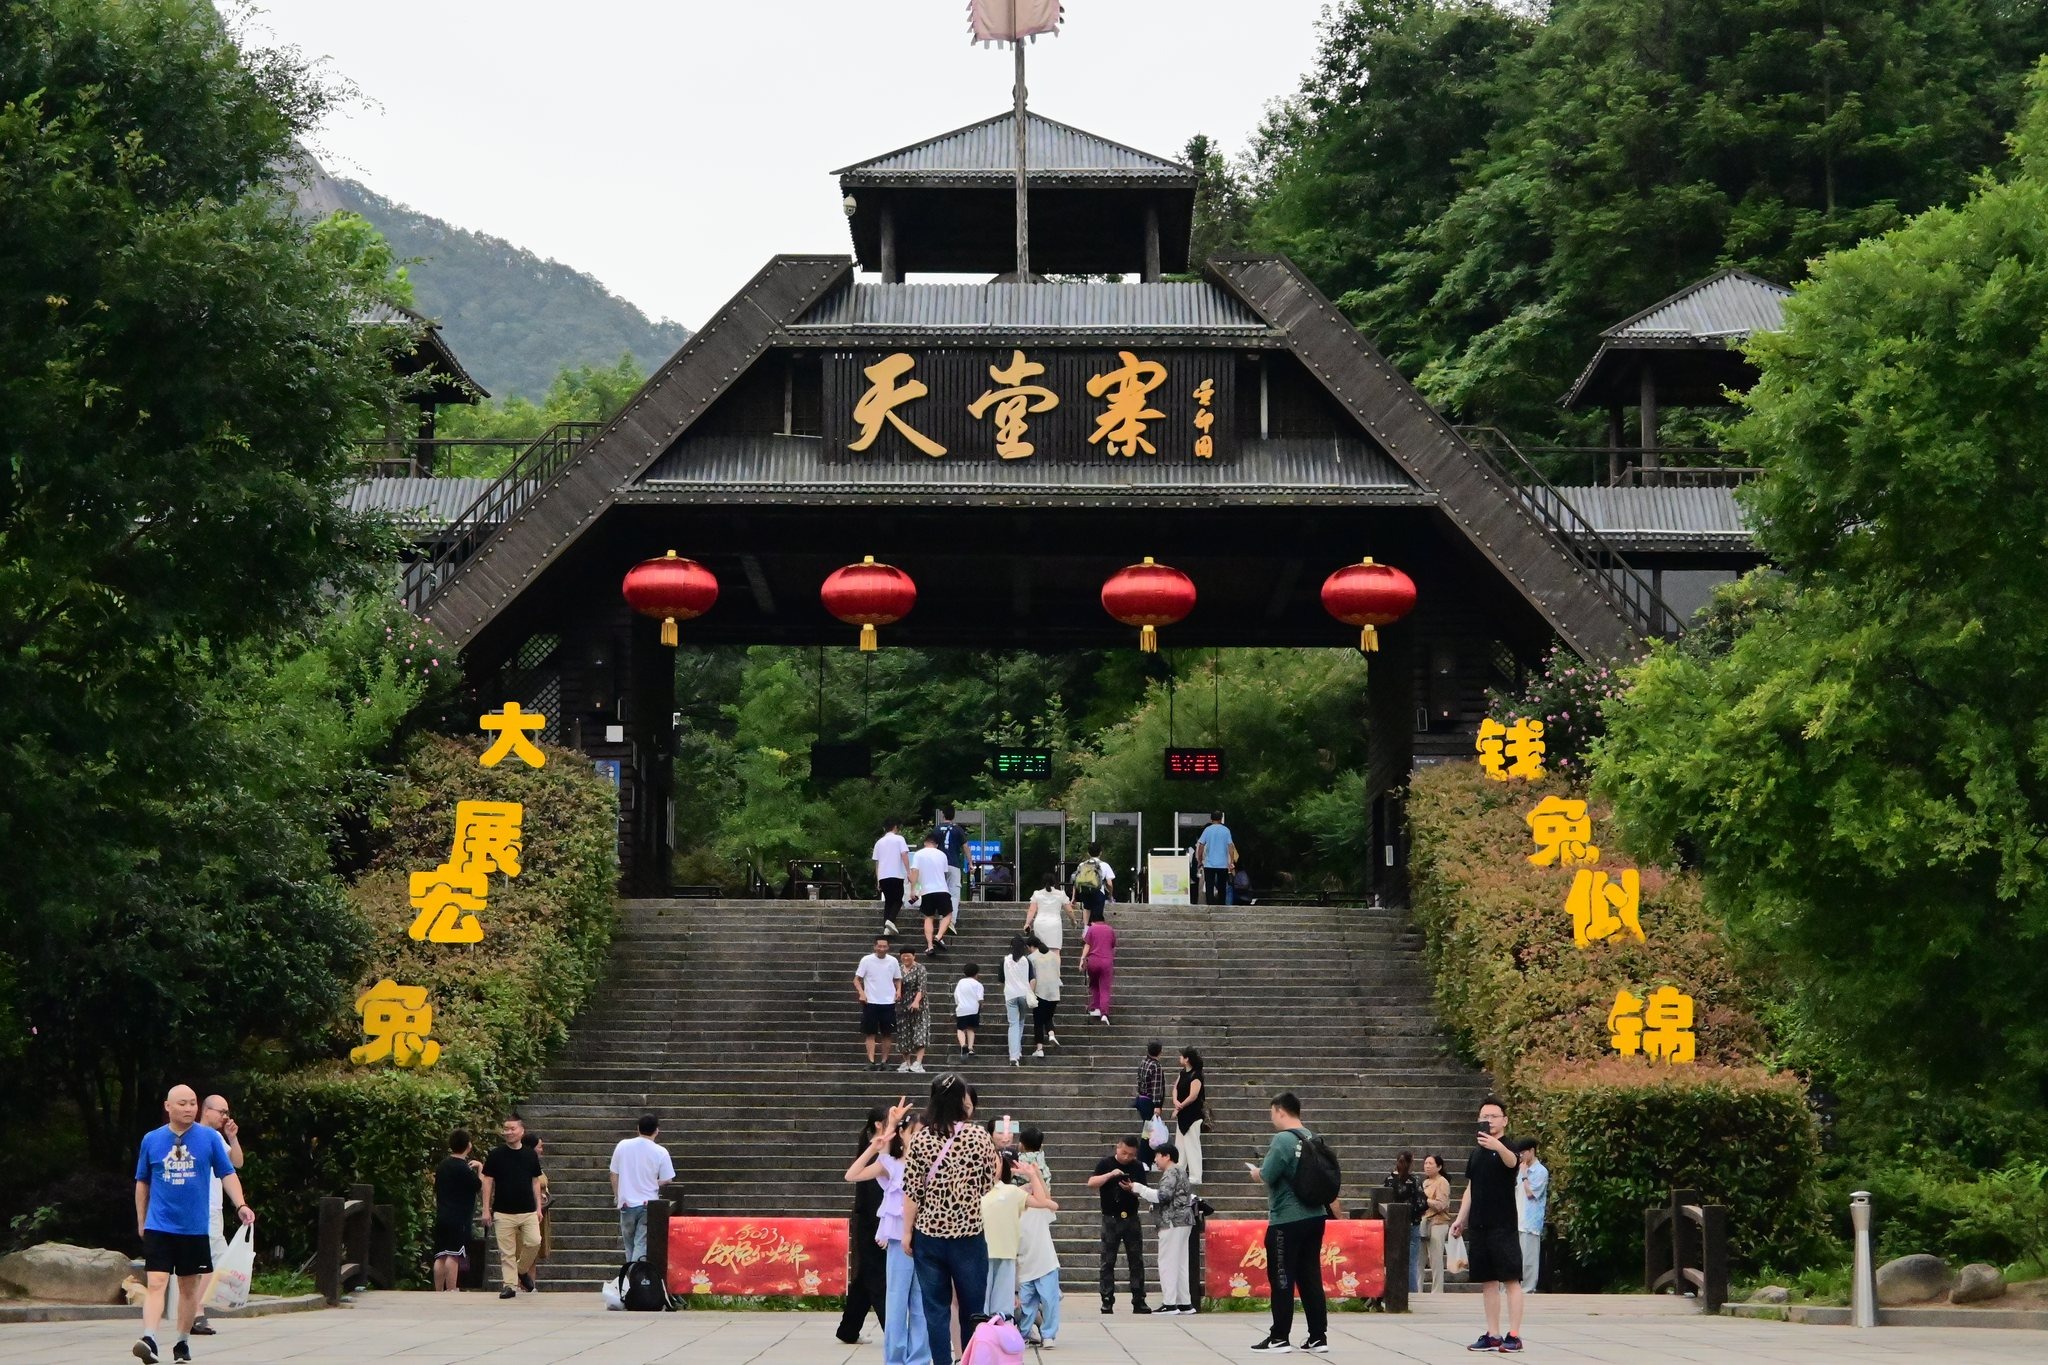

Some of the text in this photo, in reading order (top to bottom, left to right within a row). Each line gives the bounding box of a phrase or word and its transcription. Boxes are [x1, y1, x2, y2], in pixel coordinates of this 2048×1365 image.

[848, 350, 1168, 459] 天堂寨
[350, 701, 546, 1068] 大展宏兔
[1475, 718, 1696, 1064] 钱兔似锦
[735, 1224, 778, 1246] 2023
